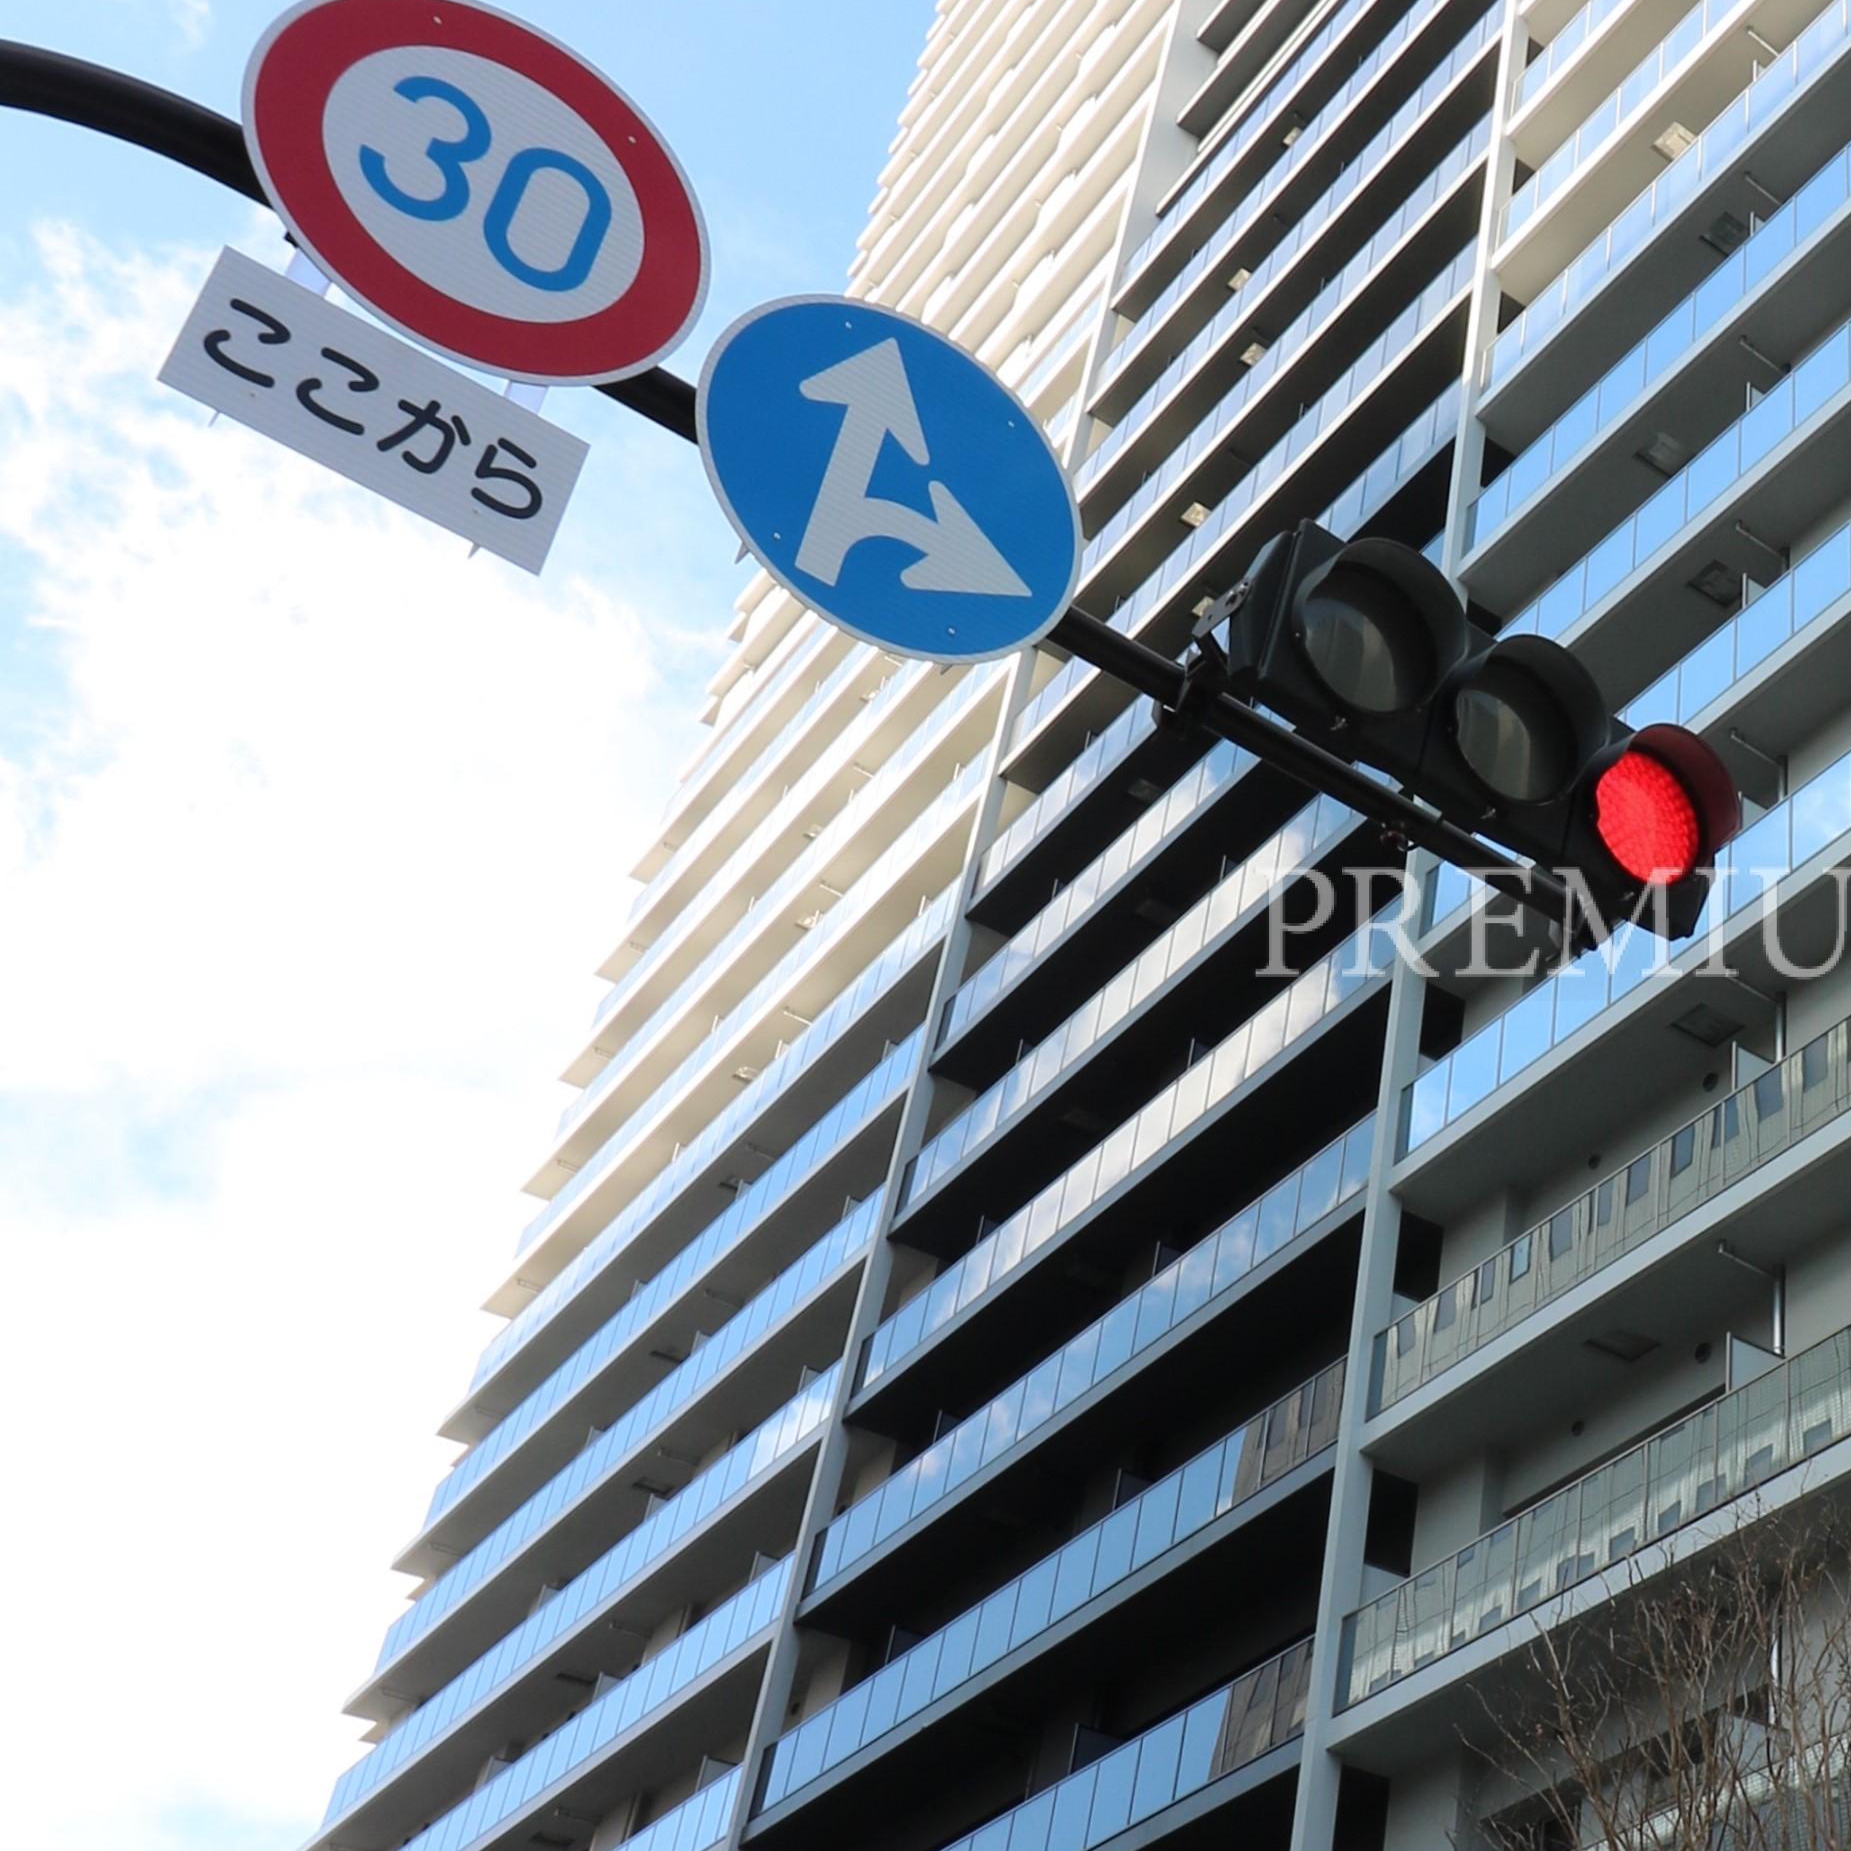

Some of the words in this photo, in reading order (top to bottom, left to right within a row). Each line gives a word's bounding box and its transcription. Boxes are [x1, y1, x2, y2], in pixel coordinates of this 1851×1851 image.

[359, 75, 612, 292] 30
[203, 297, 543, 520] ここから
